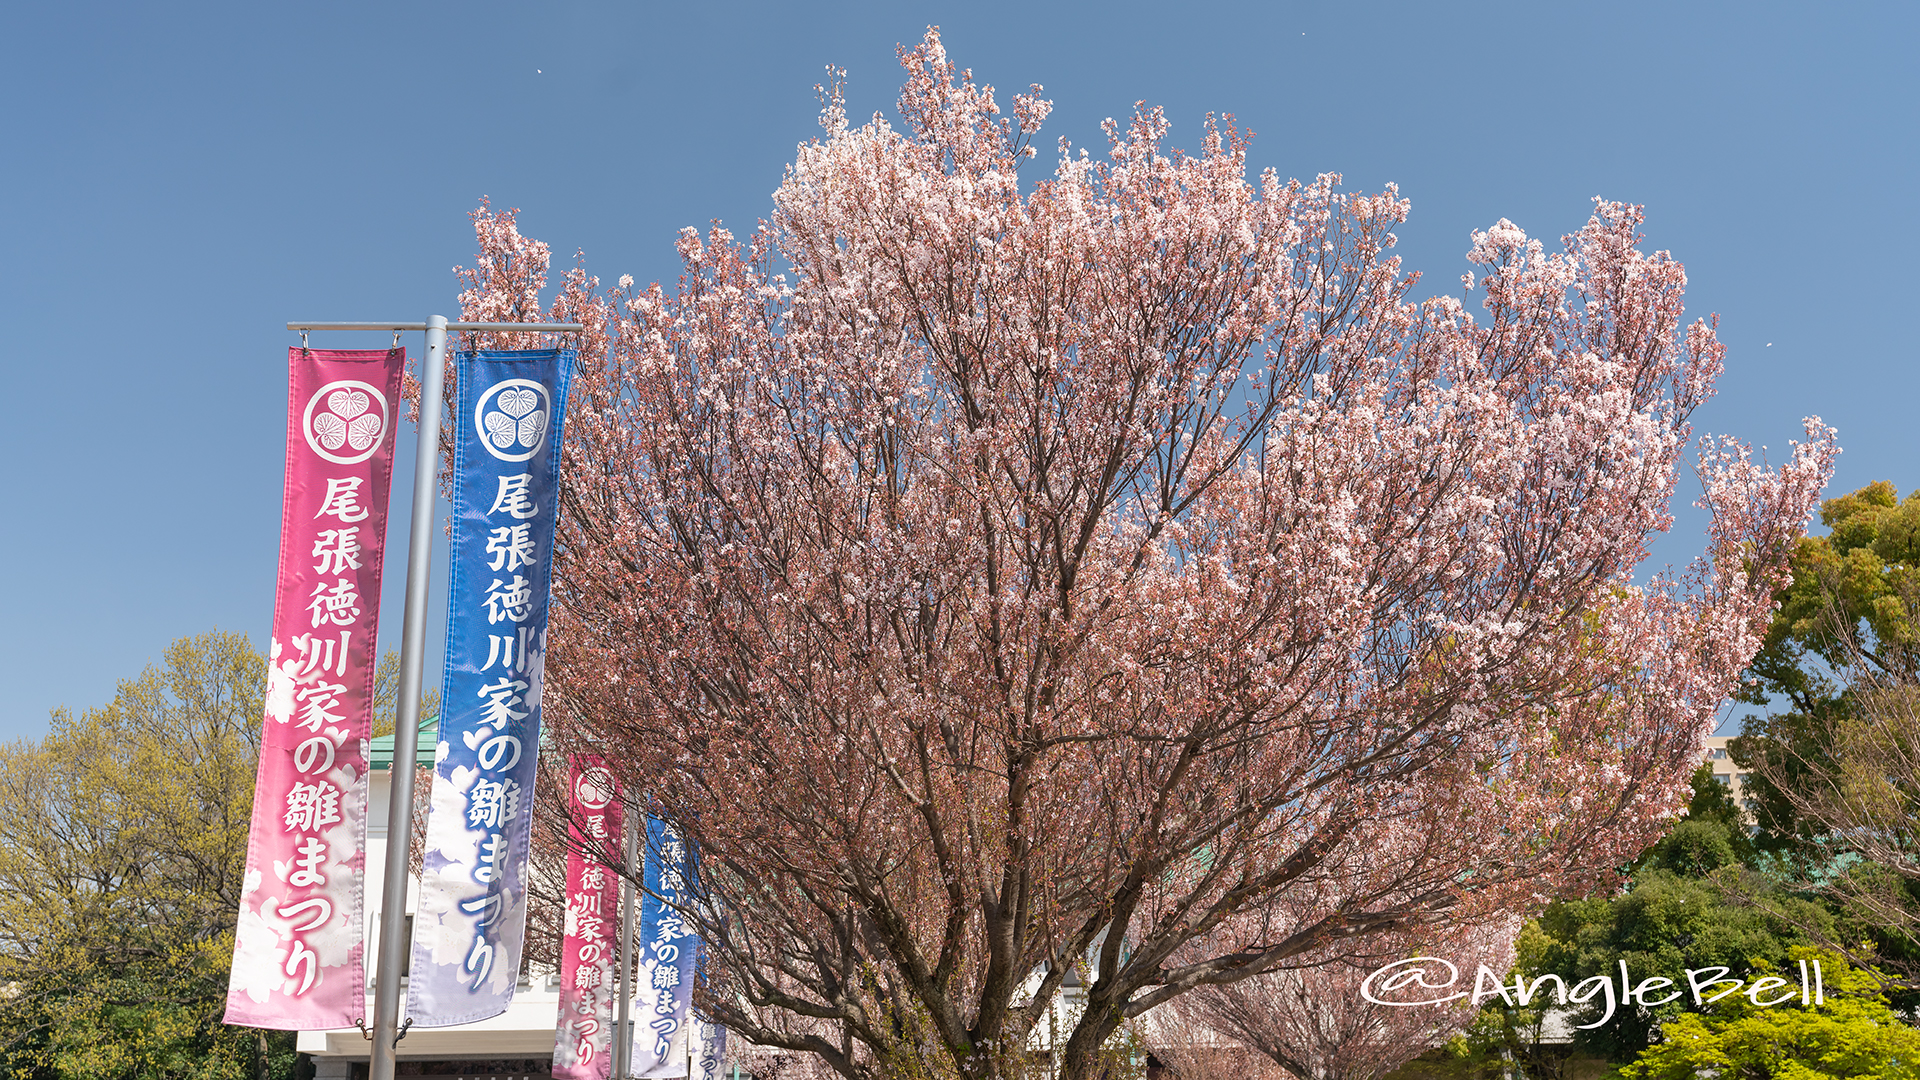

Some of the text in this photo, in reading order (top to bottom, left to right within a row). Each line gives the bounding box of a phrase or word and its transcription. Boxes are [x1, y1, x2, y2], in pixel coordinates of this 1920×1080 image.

[277, 476, 369, 996] 尾張徳川家の雛まつり
[462, 473, 539, 990] 尾張徳川家の雛まつり
